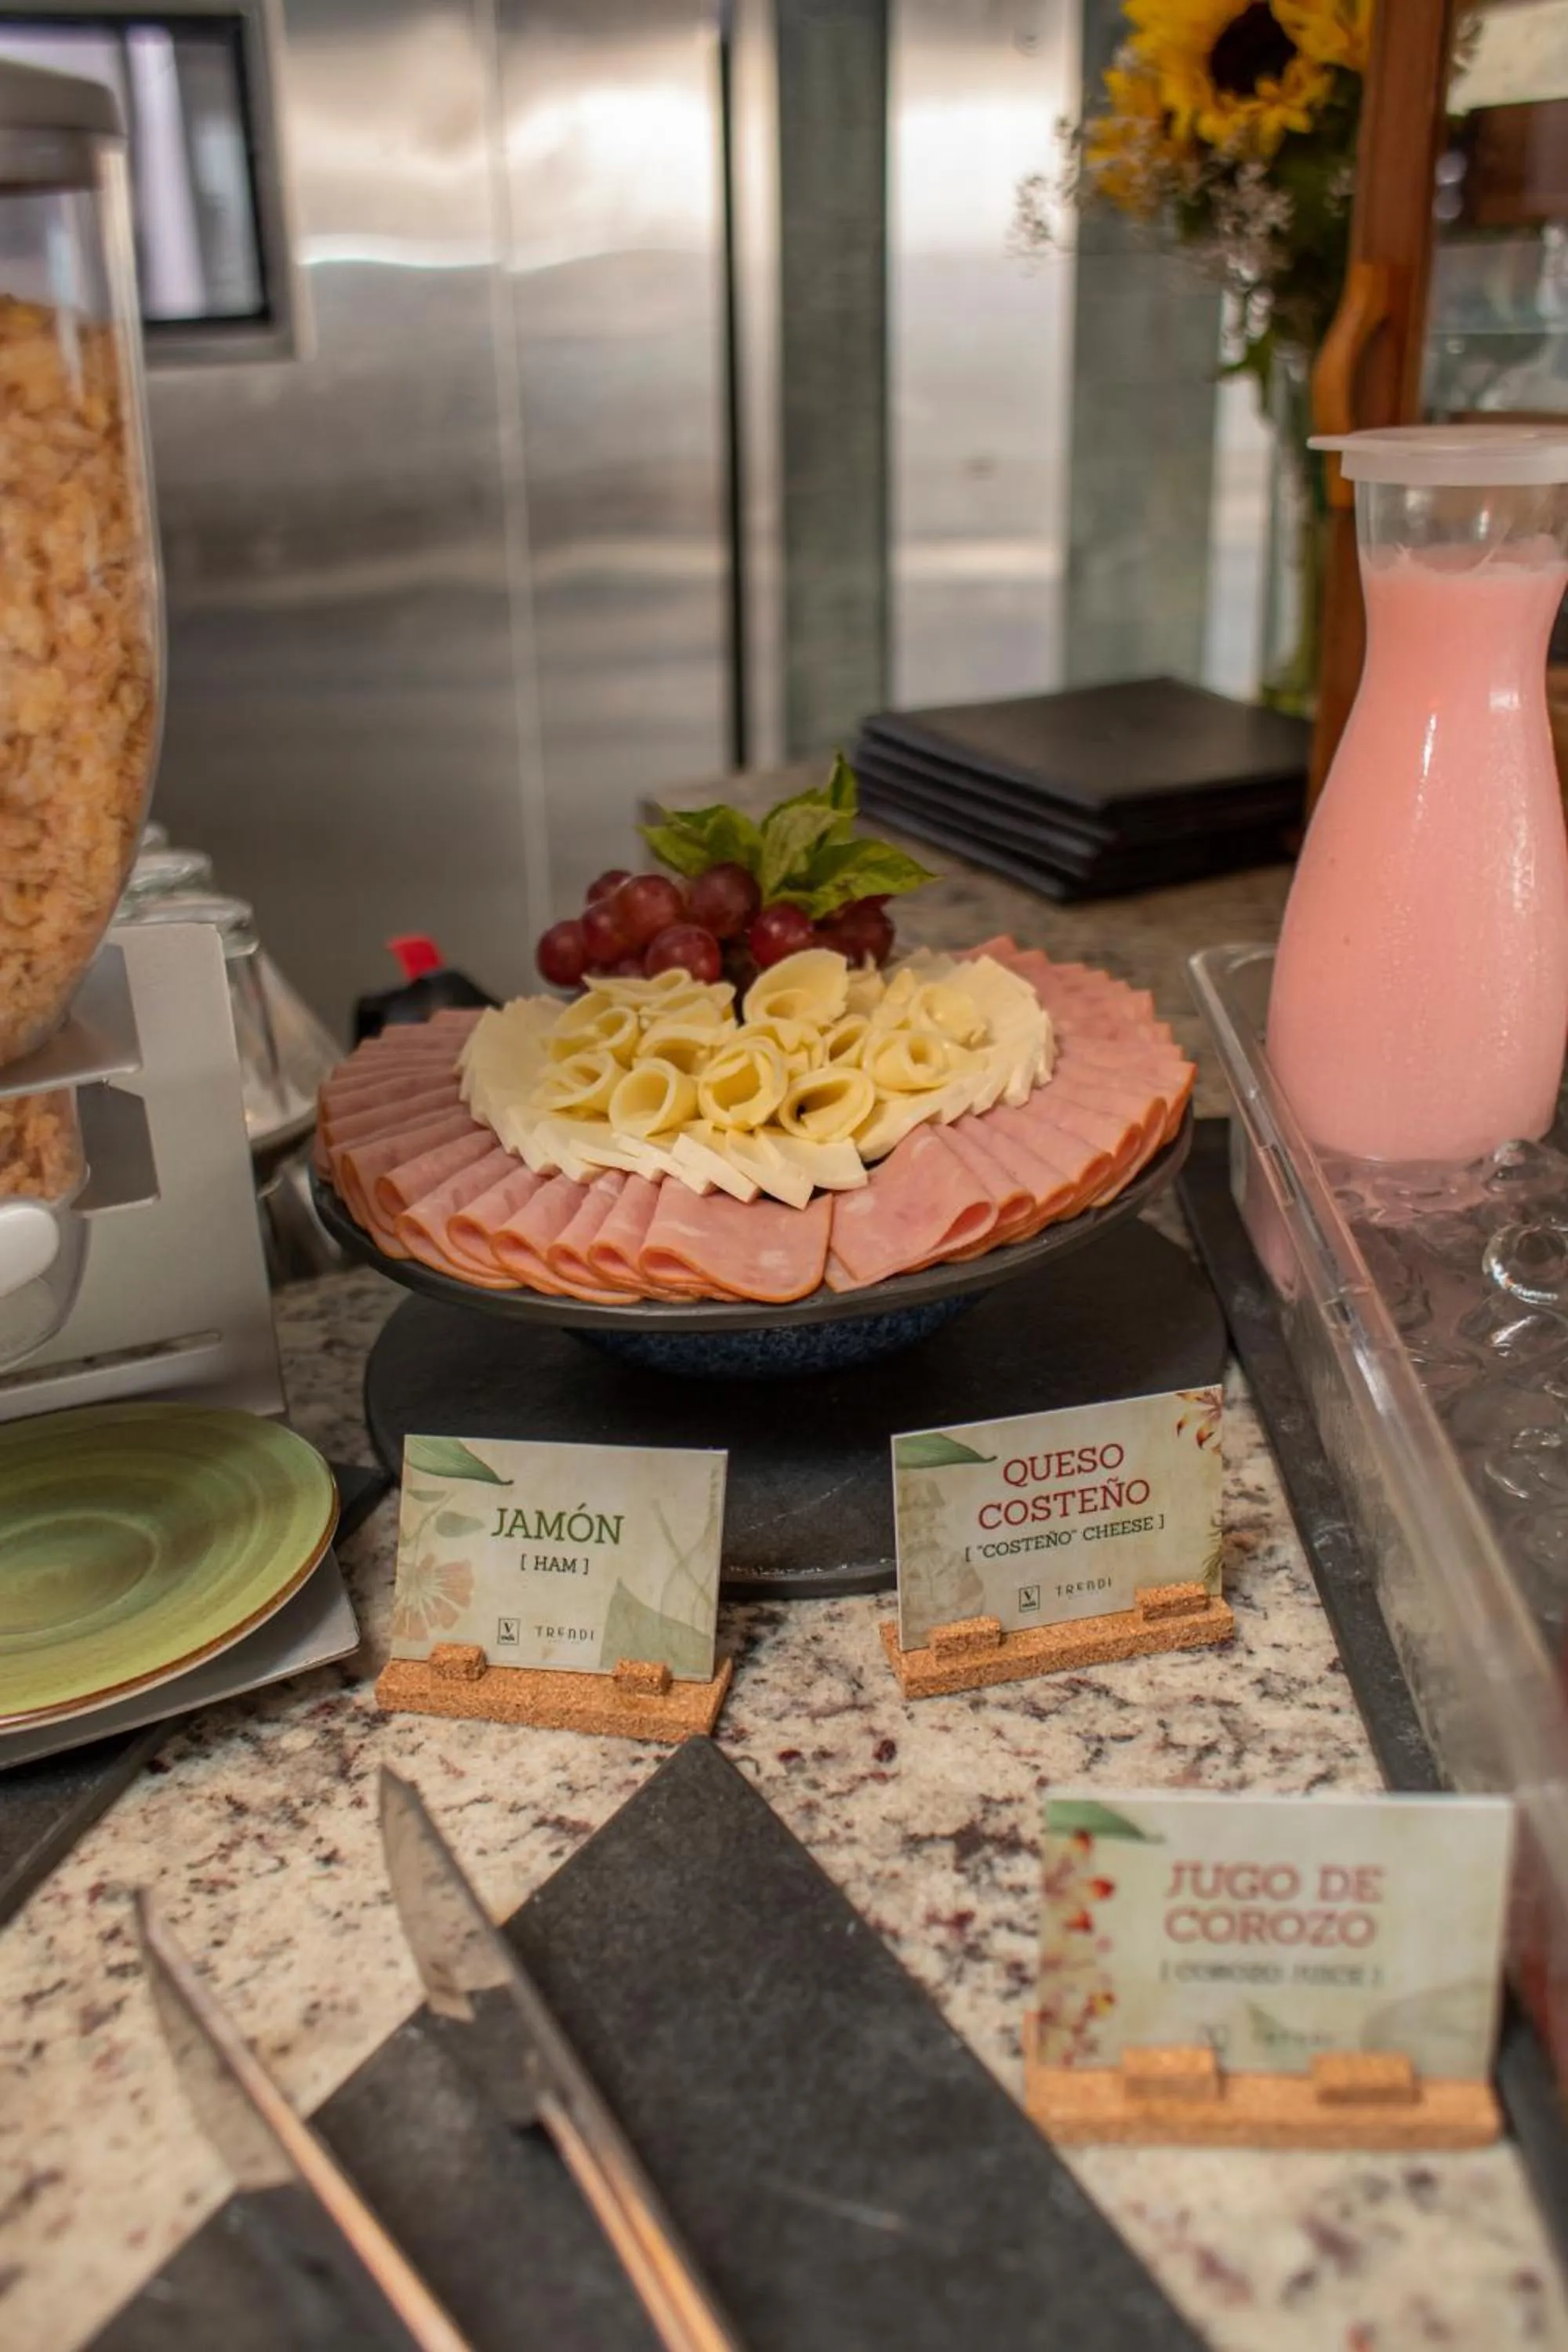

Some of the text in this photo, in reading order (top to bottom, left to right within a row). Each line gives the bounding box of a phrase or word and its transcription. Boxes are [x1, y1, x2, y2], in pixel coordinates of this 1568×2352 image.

[1003, 1443, 1124, 1487] QUESO
[491, 1501, 626, 1545] JAMÓN
[978, 1476, 1151, 1530] COSTEÑO
[1082, 1515, 1155, 1541] CHEESE
[533, 1555, 579, 1575] HAM
[1163, 1860, 1385, 1905] JUGO DE
[1164, 1905, 1378, 1950] COROZO
